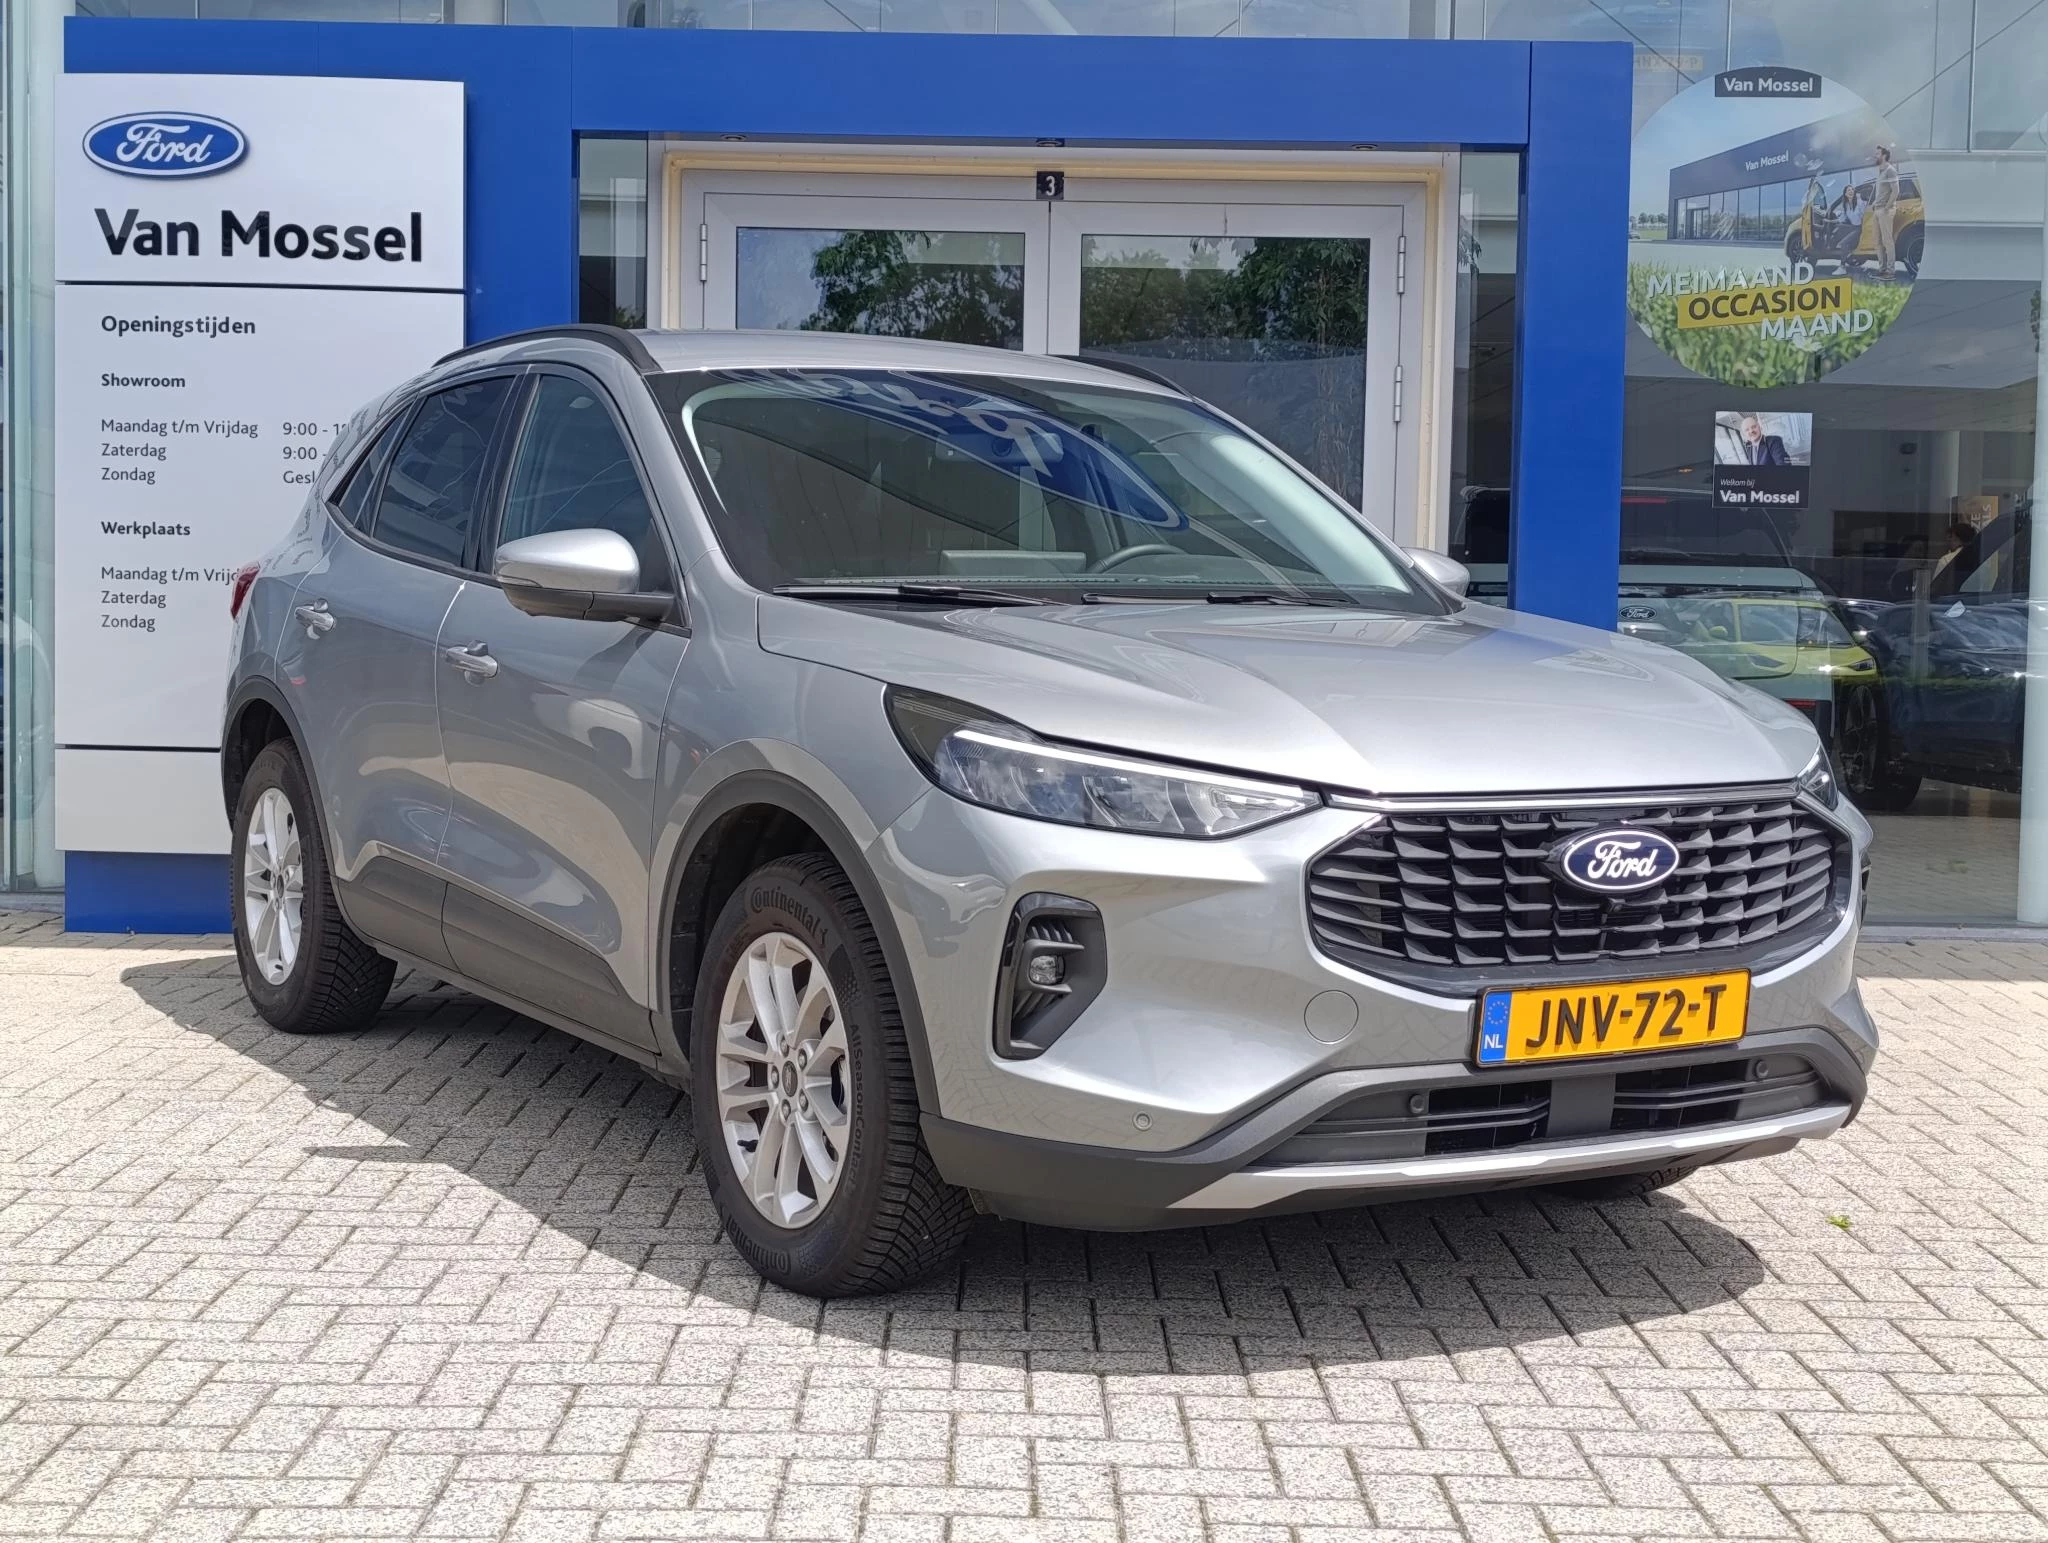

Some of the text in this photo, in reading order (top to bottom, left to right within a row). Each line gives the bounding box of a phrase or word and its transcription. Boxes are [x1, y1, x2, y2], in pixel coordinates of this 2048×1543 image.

[1723, 77, 1813, 92] Van Mossel
[115, 122, 214, 164] Ford
[1745, 149, 1789, 172] Van Mossel
[1046, 175, 1056, 196] 3
[95, 208, 422, 263] Van Mossel
[1688, 286, 1841, 321] OCCASION
[101, 315, 256, 338] Openingstijden
[1760, 309, 1874, 340] MAAND
[101, 373, 186, 388] Showroom
[101, 419, 168, 437] Maandag
[171, 419, 200, 434] t/m
[204, 420, 259, 438] Vrijdag
[282, 422, 318, 436] 9:00
[101, 443, 167, 461] Zaterdag
[282, 446, 318, 460] 9:00
[101, 467, 156, 485] Zondag
[1720, 479, 1746, 487] Welkom
[1720, 489, 1800, 504] Van Mossel
[101, 521, 191, 539] Werkplaats
[101, 567, 168, 584] Maandag
[171, 568, 200, 582] t/m
[101, 591, 167, 609] Zaterdag
[1626, 608, 1650, 618] Ford
[101, 615, 156, 633] Zondag
[1587, 841, 1659, 879] Ford
[750, 885, 821, 939] Continental
[1525, 983, 1728, 1049] JNV-72-T
[1483, 1033, 1504, 1049] NL
